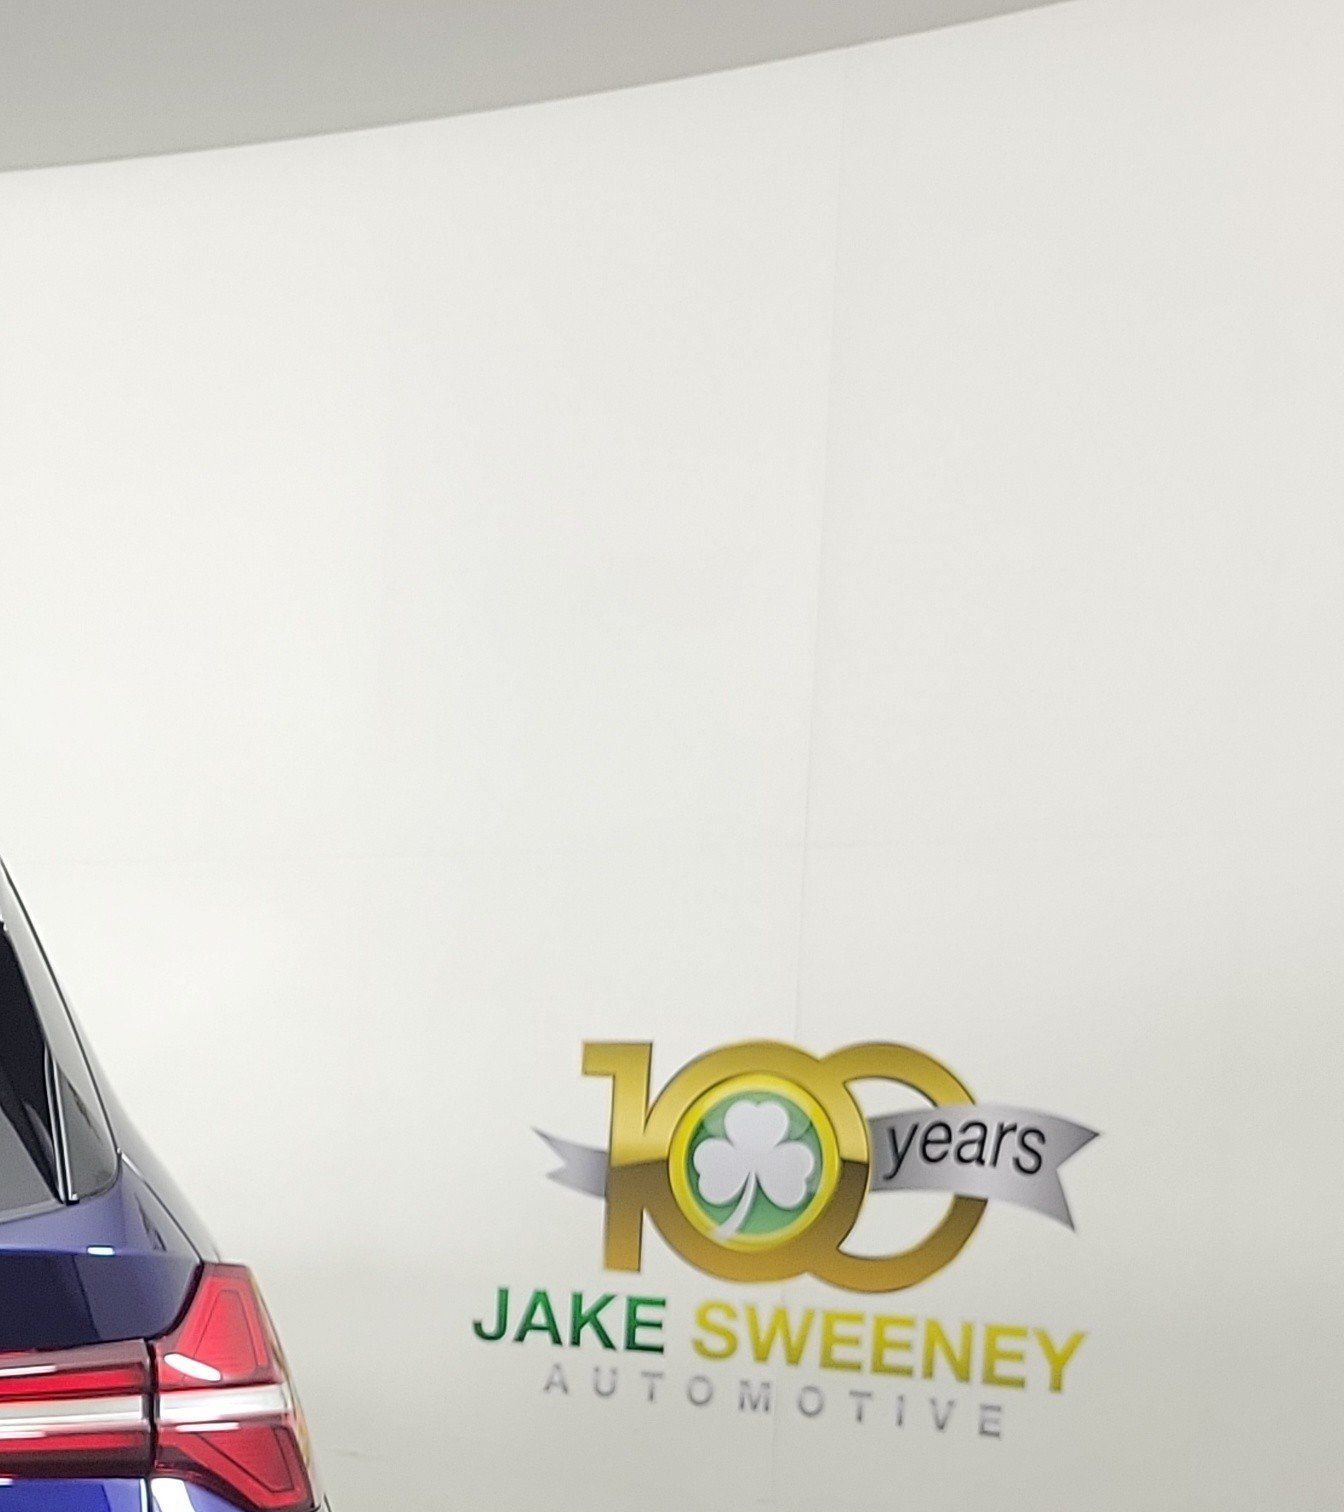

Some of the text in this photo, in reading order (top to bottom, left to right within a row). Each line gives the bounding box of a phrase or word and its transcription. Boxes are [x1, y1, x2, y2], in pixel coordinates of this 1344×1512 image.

[582, 1040, 989, 1294] 100
[882, 1120, 1047, 1180] years
[472, 1287, 1088, 1393] JAKE SWEENEY
[542, 1363, 1003, 1438] AUTOMOTIVE
